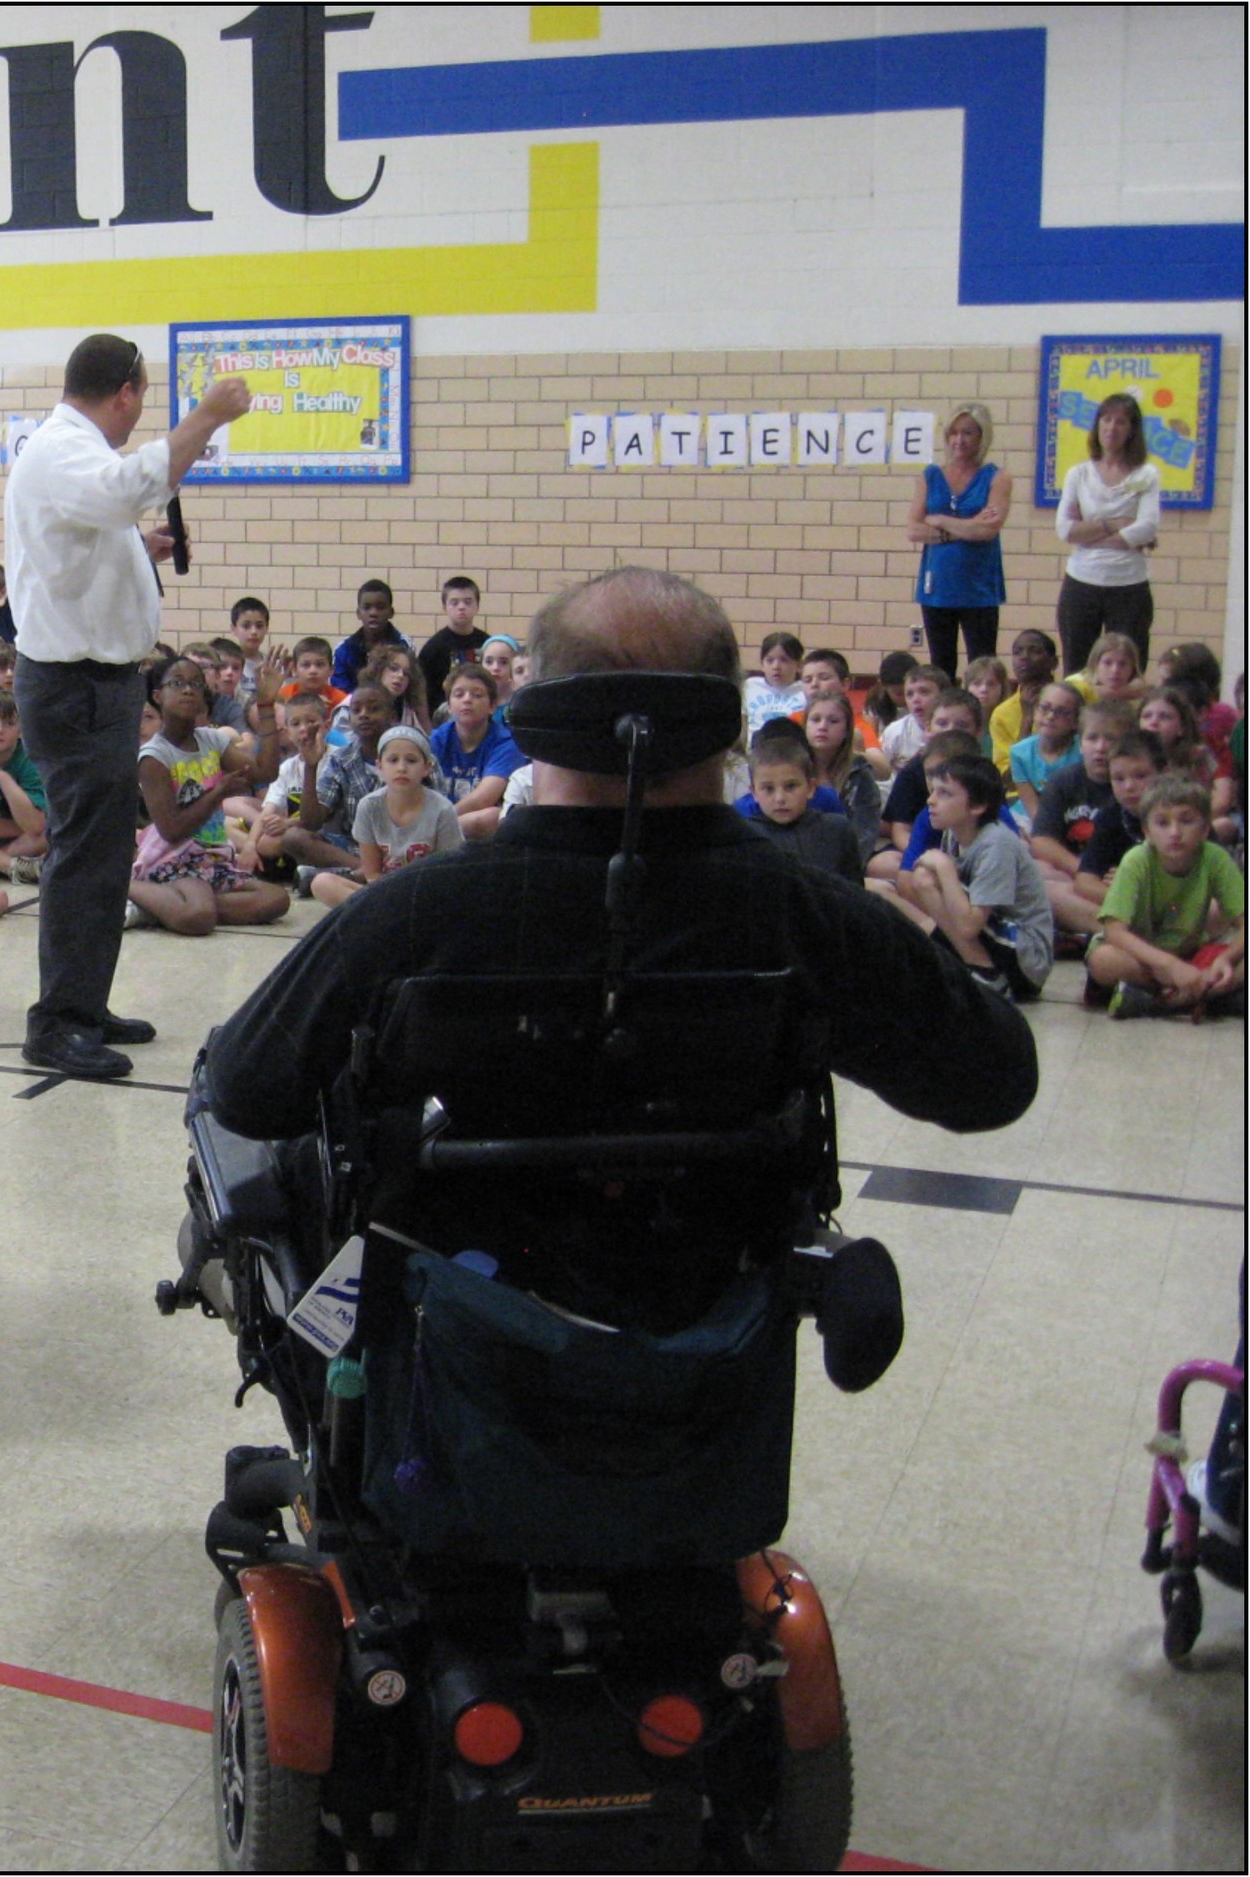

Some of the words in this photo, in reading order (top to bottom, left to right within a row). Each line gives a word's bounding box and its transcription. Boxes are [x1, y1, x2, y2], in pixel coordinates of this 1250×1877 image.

[215, 352, 253, 373] This
[254, 352, 269, 370] Is
[272, 350, 312, 369] How
[312, 349, 339, 371] My
[342, 344, 396, 368] Class
[284, 370, 300, 388] Is
[1086, 359, 1161, 379] APRIL
[293, 393, 362, 414] Healthy
[582, 427, 922, 456] PATIENCE
[518, 1793, 652, 1809] QUANTUM
